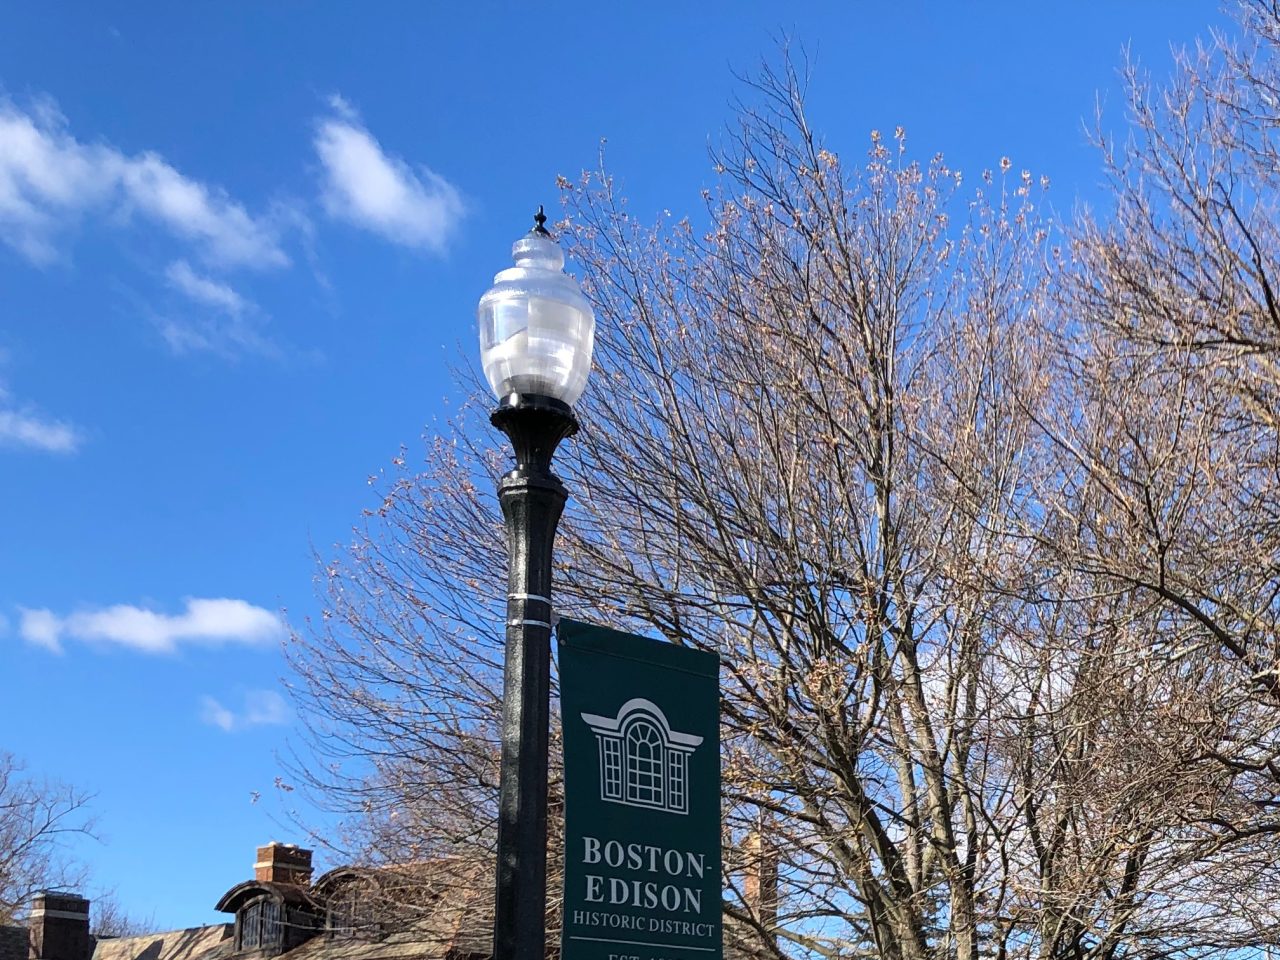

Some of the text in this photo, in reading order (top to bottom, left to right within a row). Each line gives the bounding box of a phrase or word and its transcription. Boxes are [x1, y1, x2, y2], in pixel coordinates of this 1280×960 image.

[582, 836, 712, 879] BOSTON-
[584, 874, 703, 914] EDISON
[573, 910, 715, 937] HISTORIC DISTRICT
